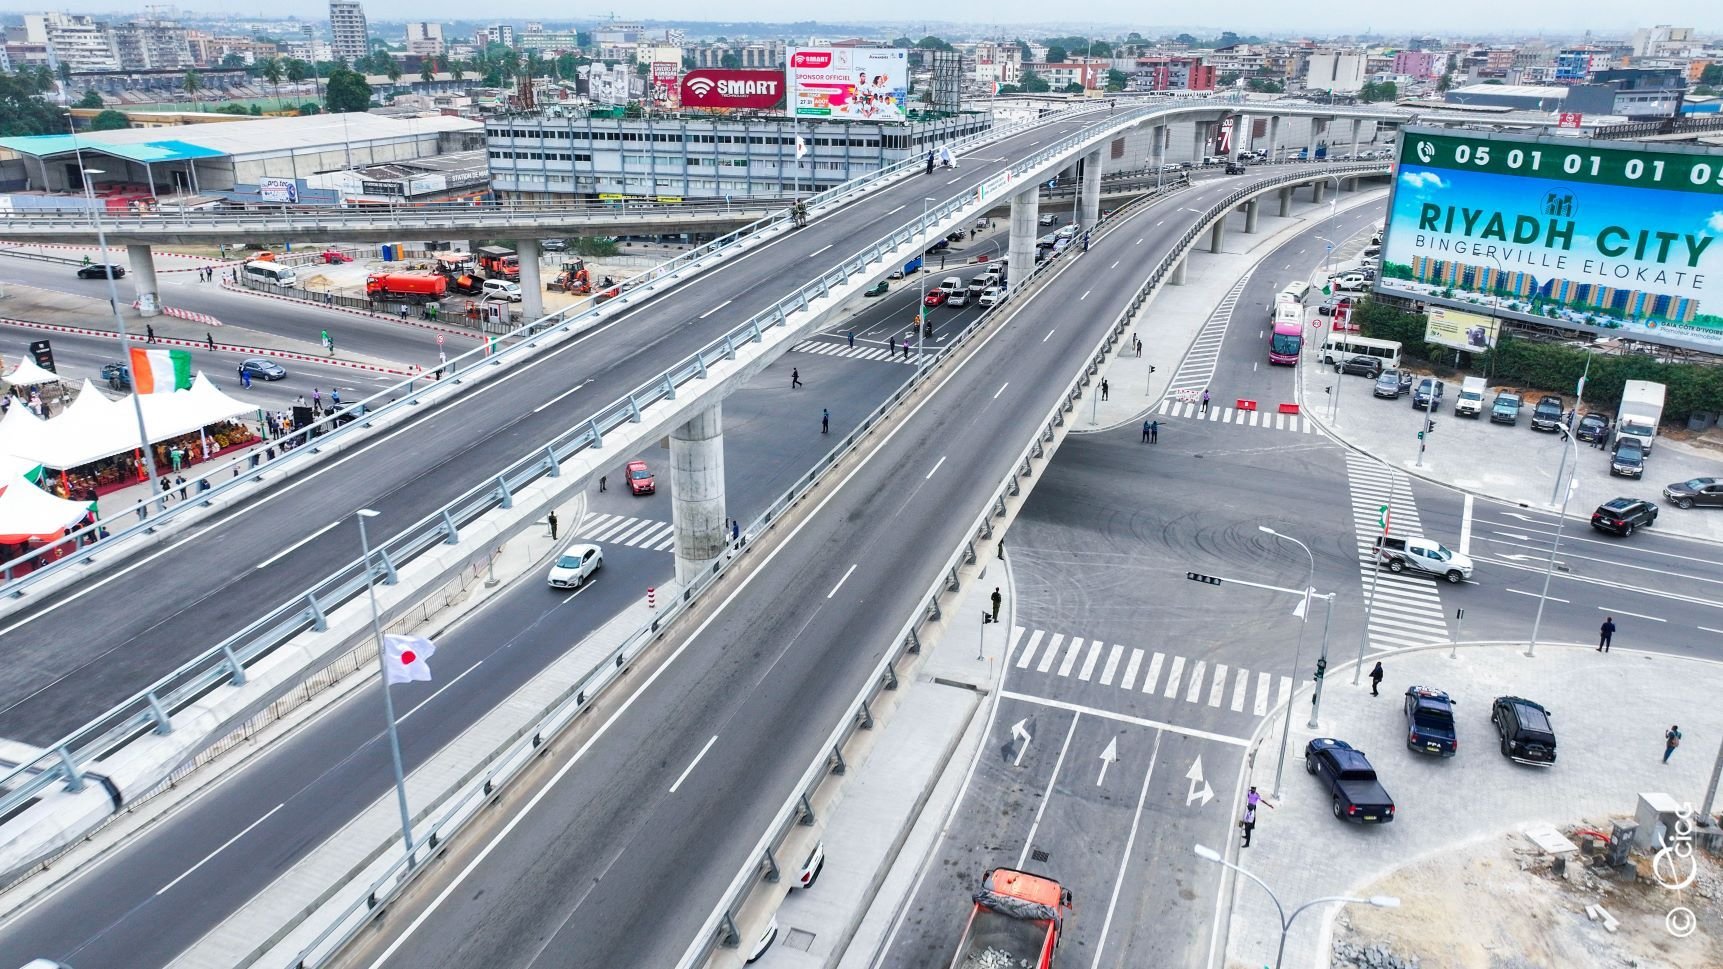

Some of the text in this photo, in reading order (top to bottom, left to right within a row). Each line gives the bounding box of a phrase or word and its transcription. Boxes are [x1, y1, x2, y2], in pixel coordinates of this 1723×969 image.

[717, 80, 777, 95] SMART
[1455, 145, 1490, 166] 05
[1507, 149, 1542, 171] 01
[1563, 153, 1601, 176] 01
[1624, 158, 1665, 181] 01
[1418, 202, 1714, 268] RIYADH CITY
[1415, 234, 1705, 290] BINGERVILLE ELOKATE
[1678, 323, 1695, 331] CÔTE
